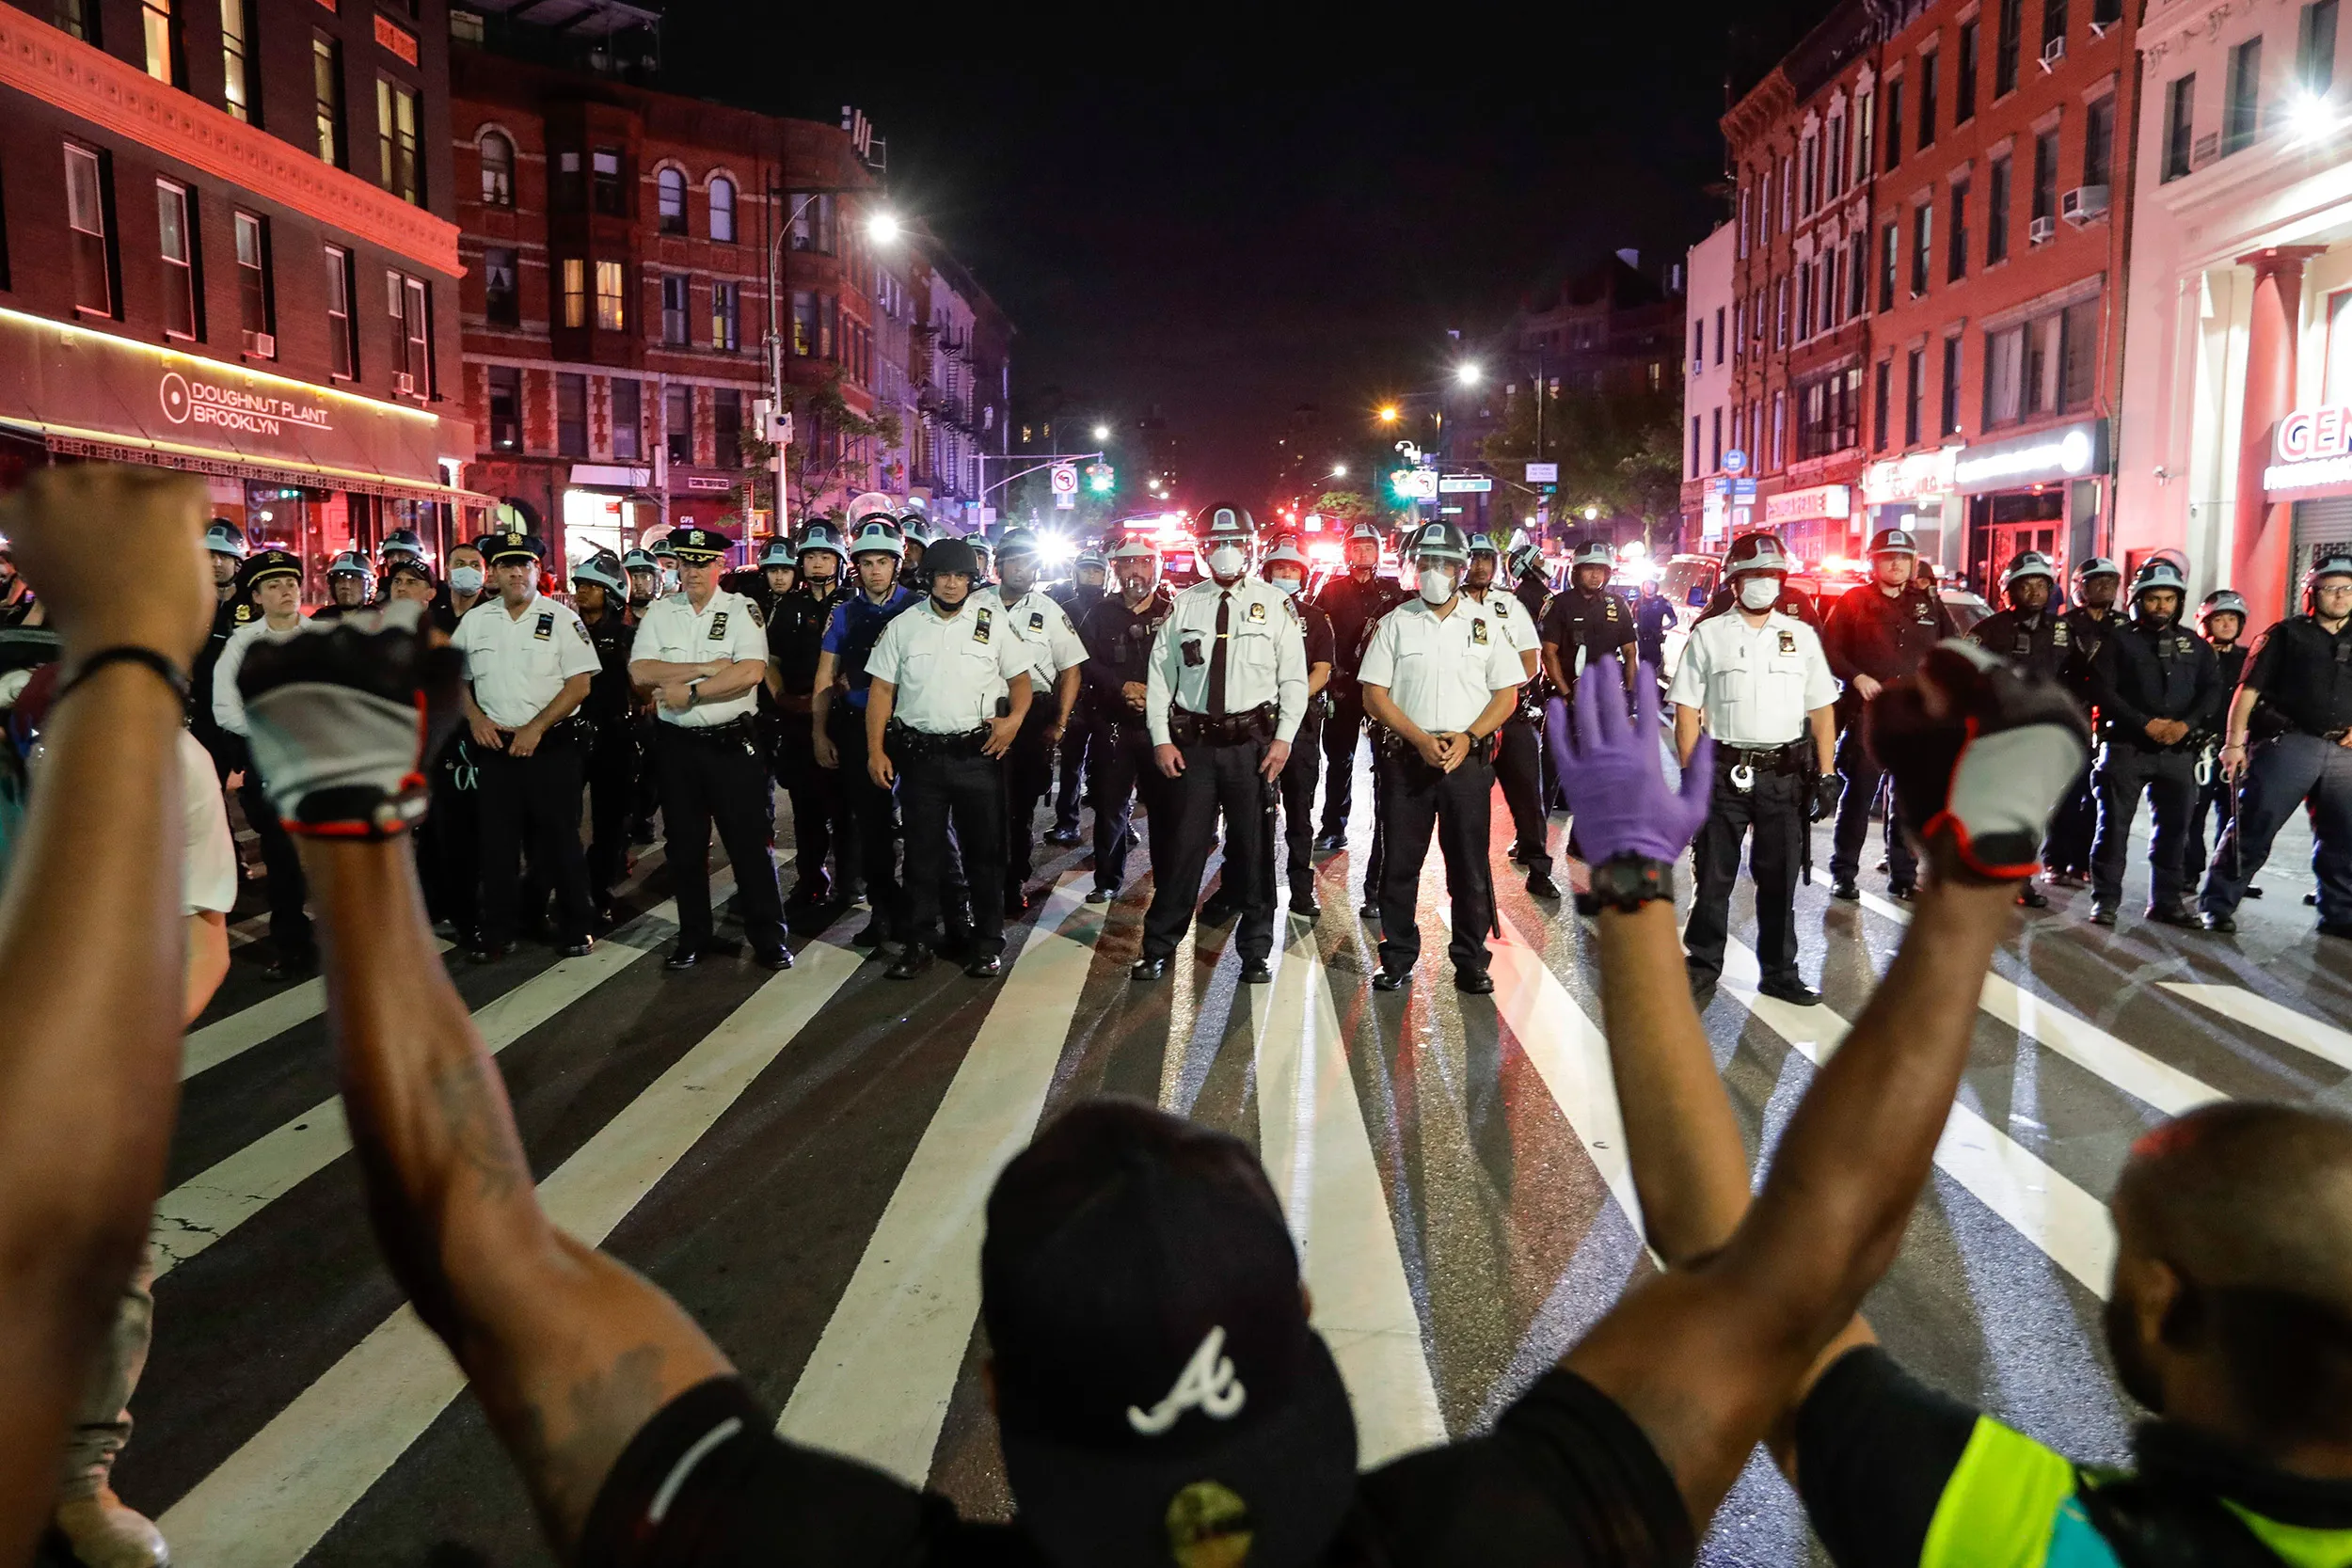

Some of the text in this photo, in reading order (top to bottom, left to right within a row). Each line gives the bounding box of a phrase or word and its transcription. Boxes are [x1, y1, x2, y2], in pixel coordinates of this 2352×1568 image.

[192, 382, 328, 424] DOUGHNUT PLANT
[194, 404, 279, 436] BROOKLYN
